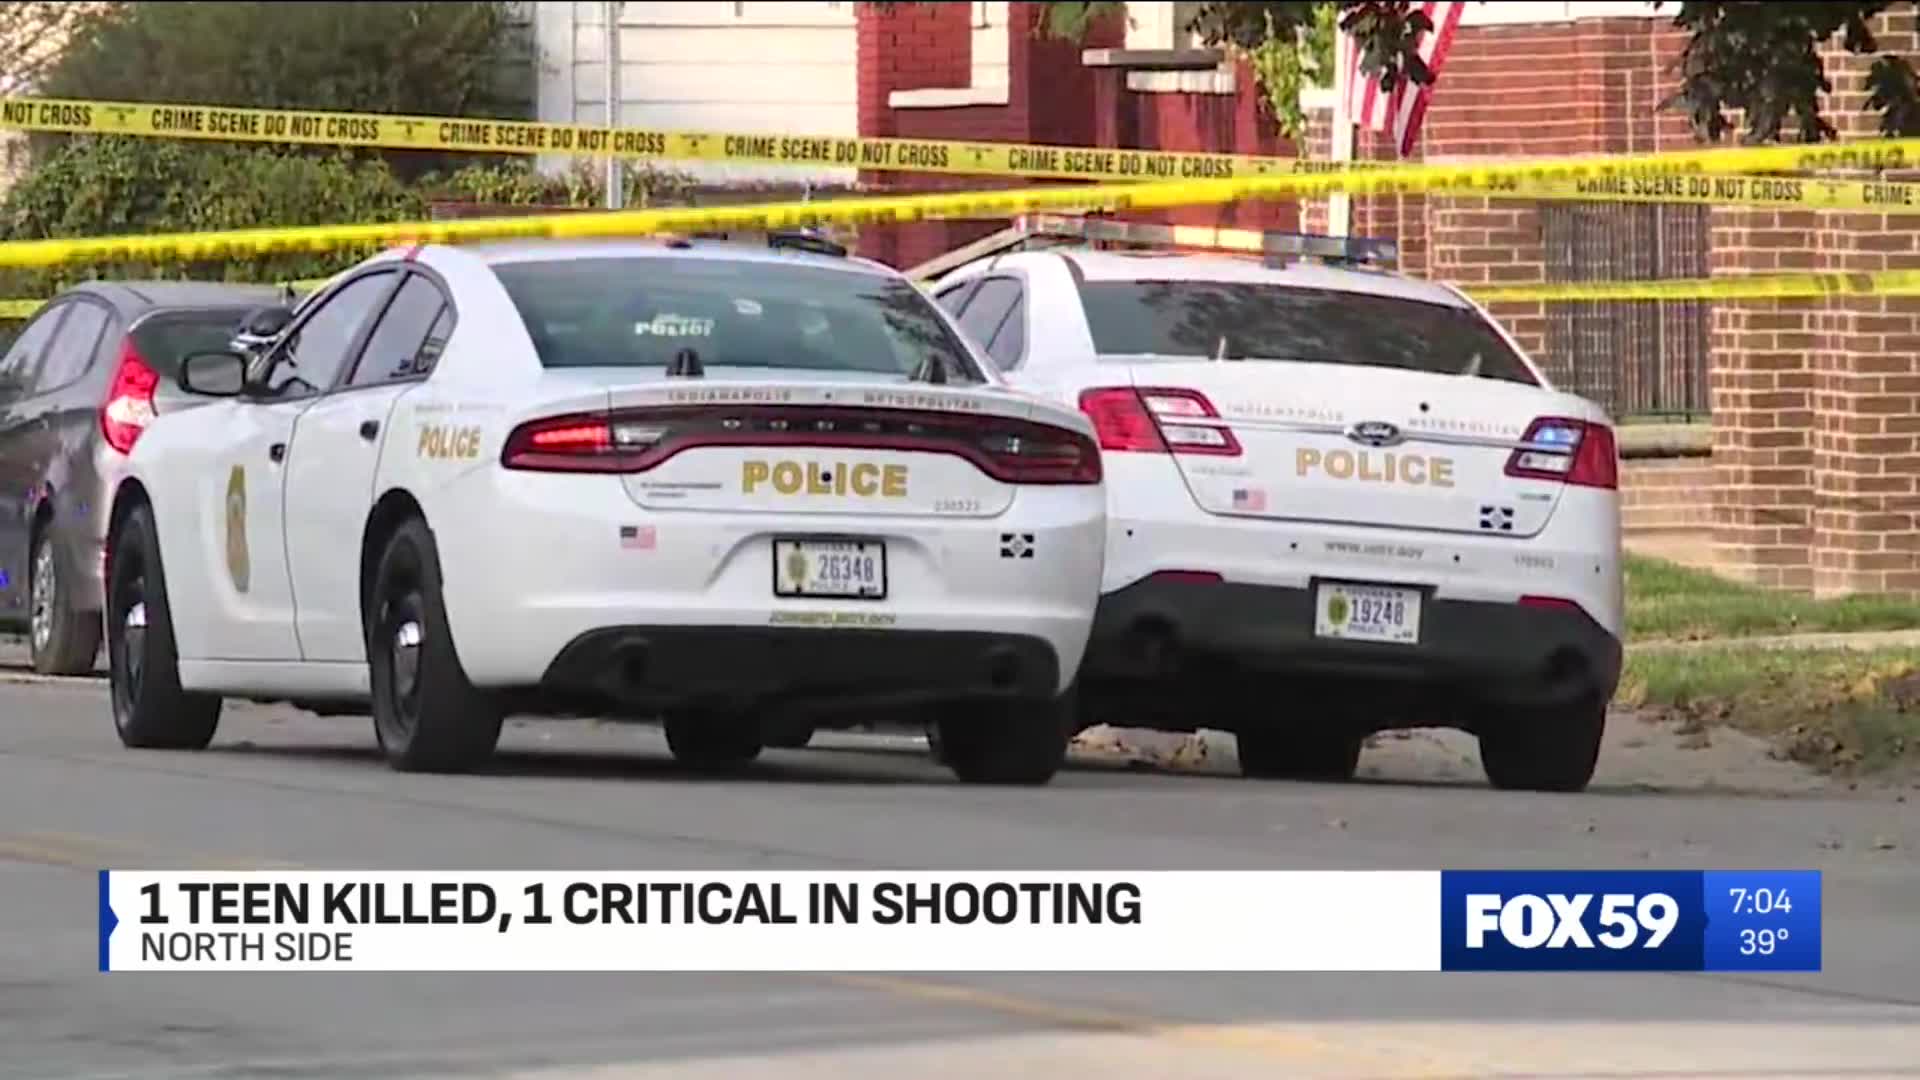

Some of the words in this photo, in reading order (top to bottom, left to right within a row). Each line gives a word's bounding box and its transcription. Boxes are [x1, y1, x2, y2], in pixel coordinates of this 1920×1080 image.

[3, 102, 34, 124] NOT
[39, 104, 92, 127] CROSS
[151, 108, 203, 131] CRIME
[207, 111, 260, 135] SCENE
[264, 114, 287, 136] DO
[291, 116, 321, 138] NOT
[326, 118, 379, 140] CROSS
[439, 122, 490, 145] CRIME
[496, 126, 546, 148] SCENE
[551, 128, 573, 149] DO
[578, 129, 609, 150] NOT
[614, 131, 666, 153] CROSS
[724, 135, 777, 158] CRIME
[780, 138, 830, 161] SCENE
[835, 141, 857, 162] DO
[862, 143, 892, 164] NOT
[898, 143, 949, 167] CROSS
[1007, 148, 1058, 170] CRIME
[1063, 151, 1114, 173] SCENE
[1118, 153, 1141, 175] DO
[1146, 155, 1177, 177] NOT
[1181, 156, 1233, 178] CROSS
[1632, 176, 1683, 197] SCENE
[1688, 177, 1711, 198] DO
[1715, 178, 1745, 199] NOT
[1750, 179, 1804, 201] CROSS
[1862, 184, 1912, 205] CRIME
[418, 423, 481, 458] POLICE
[741, 460, 909, 497] POLICE
[1295, 447, 1456, 488] POLICE
[1351, 598, 1405, 627] 19248
